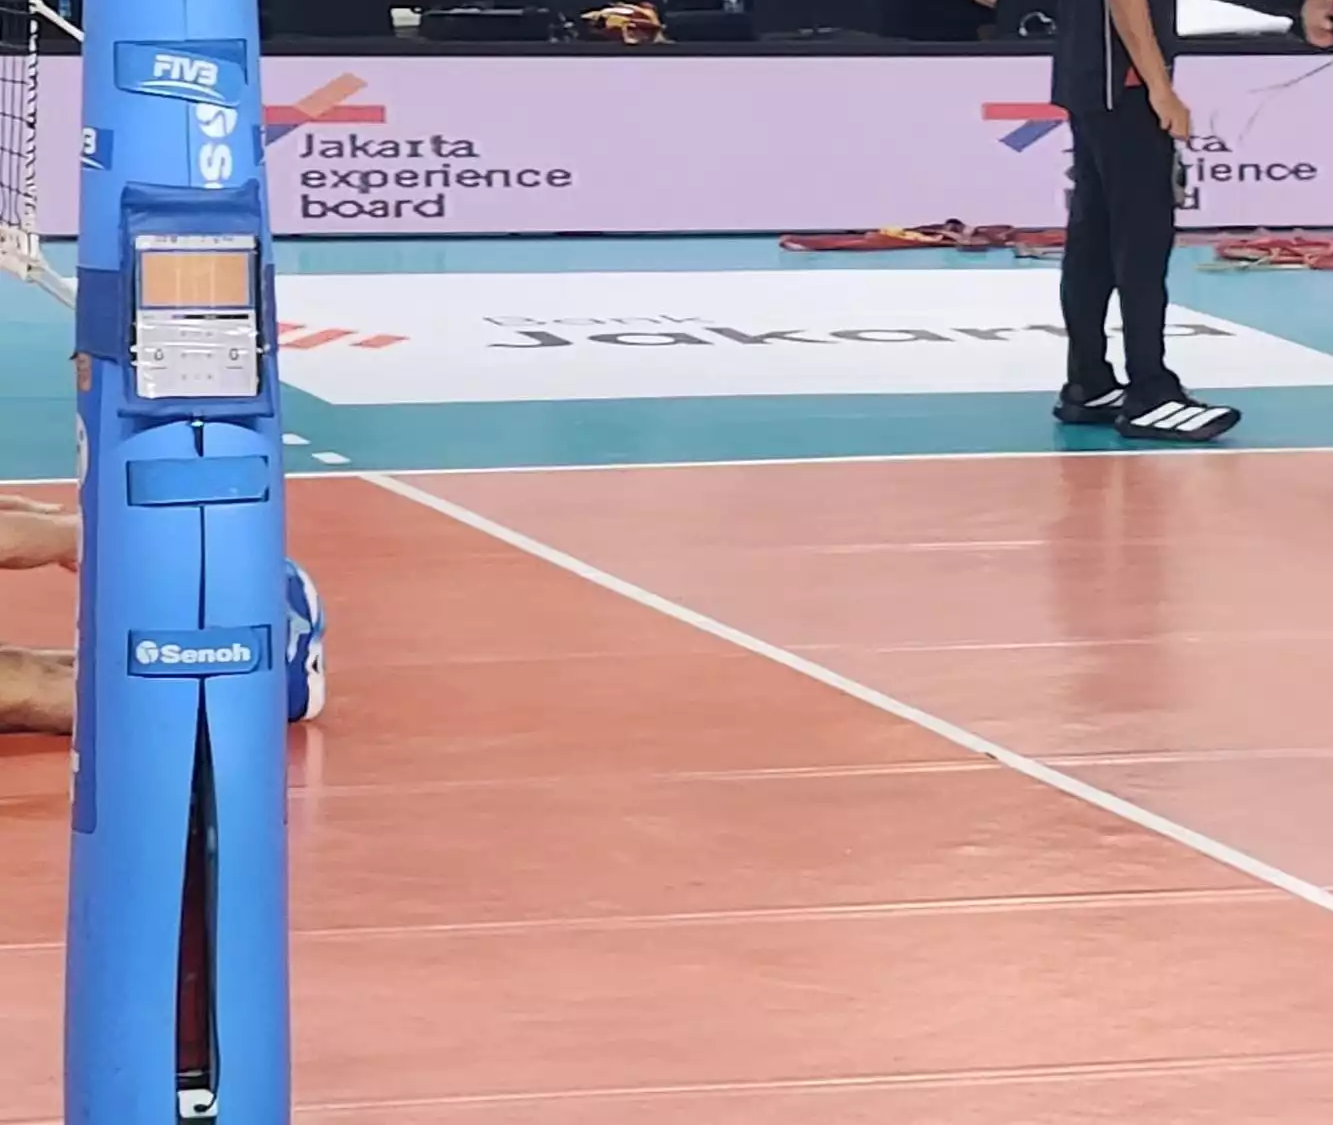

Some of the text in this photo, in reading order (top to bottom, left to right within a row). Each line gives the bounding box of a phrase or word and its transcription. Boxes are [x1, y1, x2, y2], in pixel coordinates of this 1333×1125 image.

[153, 52, 219, 87] FIVB
[299, 133, 480, 159] Jakarta
[300, 164, 573, 194] experience
[301, 193, 446, 219] board
[160, 642, 251, 664] Senoh
